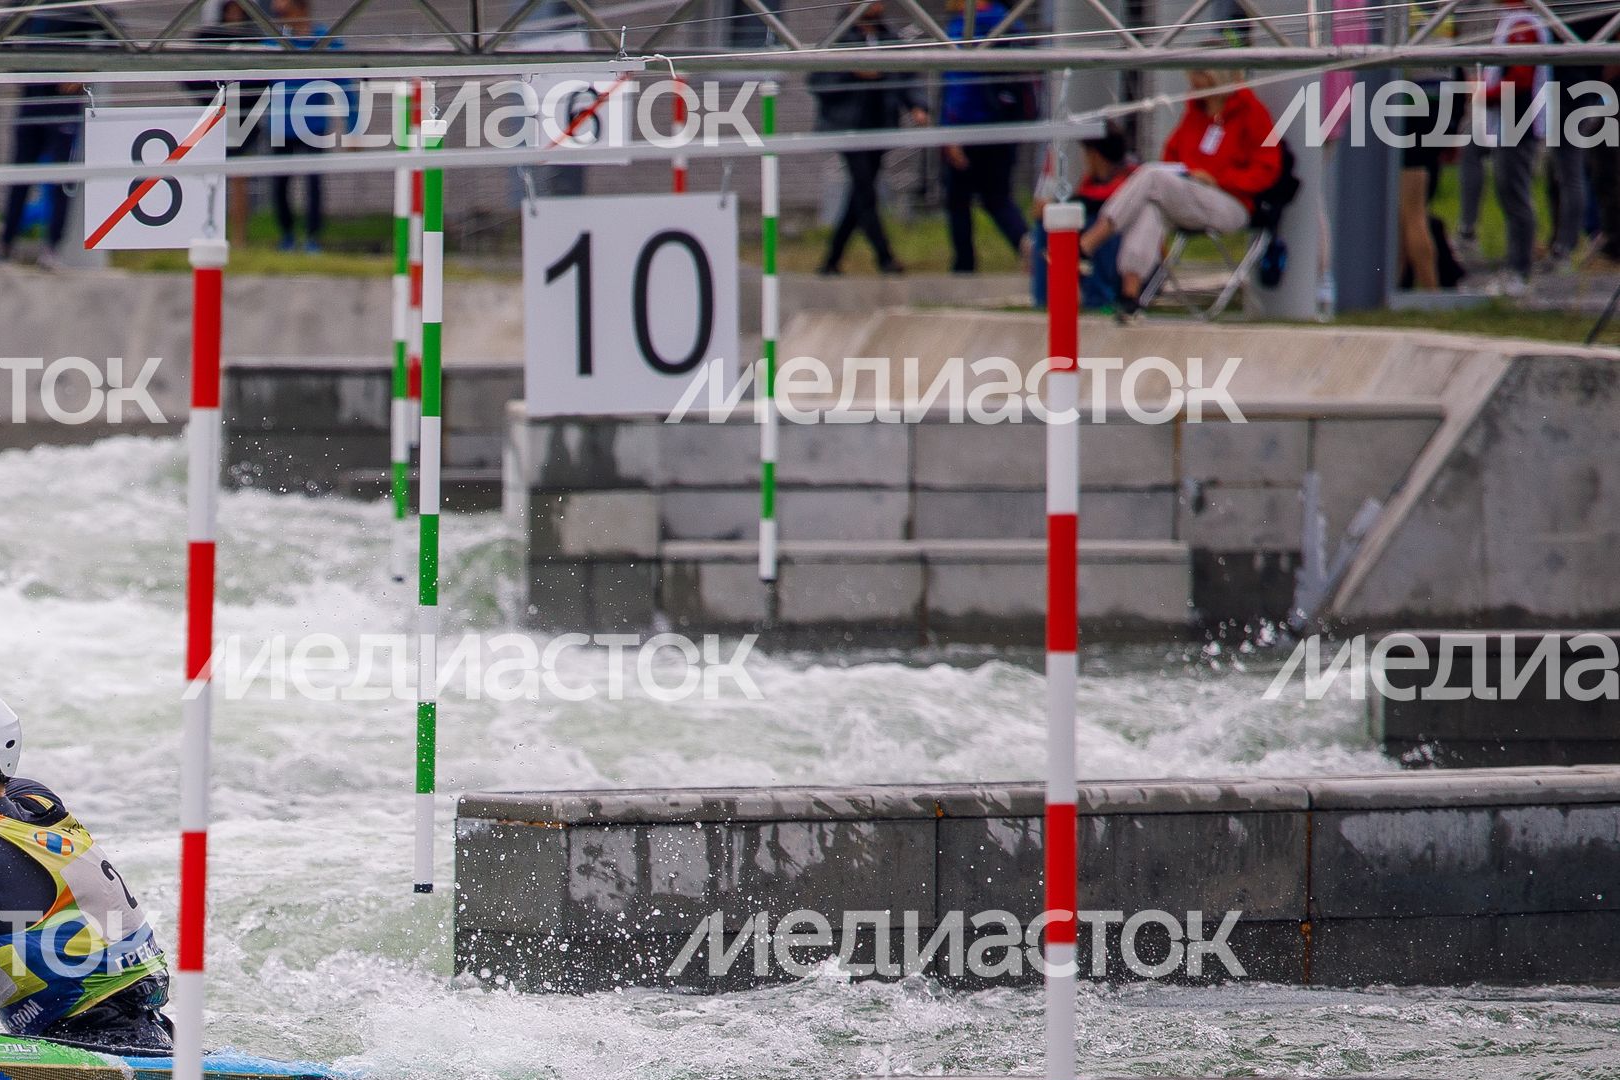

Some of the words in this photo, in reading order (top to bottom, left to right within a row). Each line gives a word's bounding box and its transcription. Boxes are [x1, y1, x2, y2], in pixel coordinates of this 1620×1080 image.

[566, 87, 601, 145] 6
[128, 128, 183, 227] 8
[545, 229, 714, 377] 10
